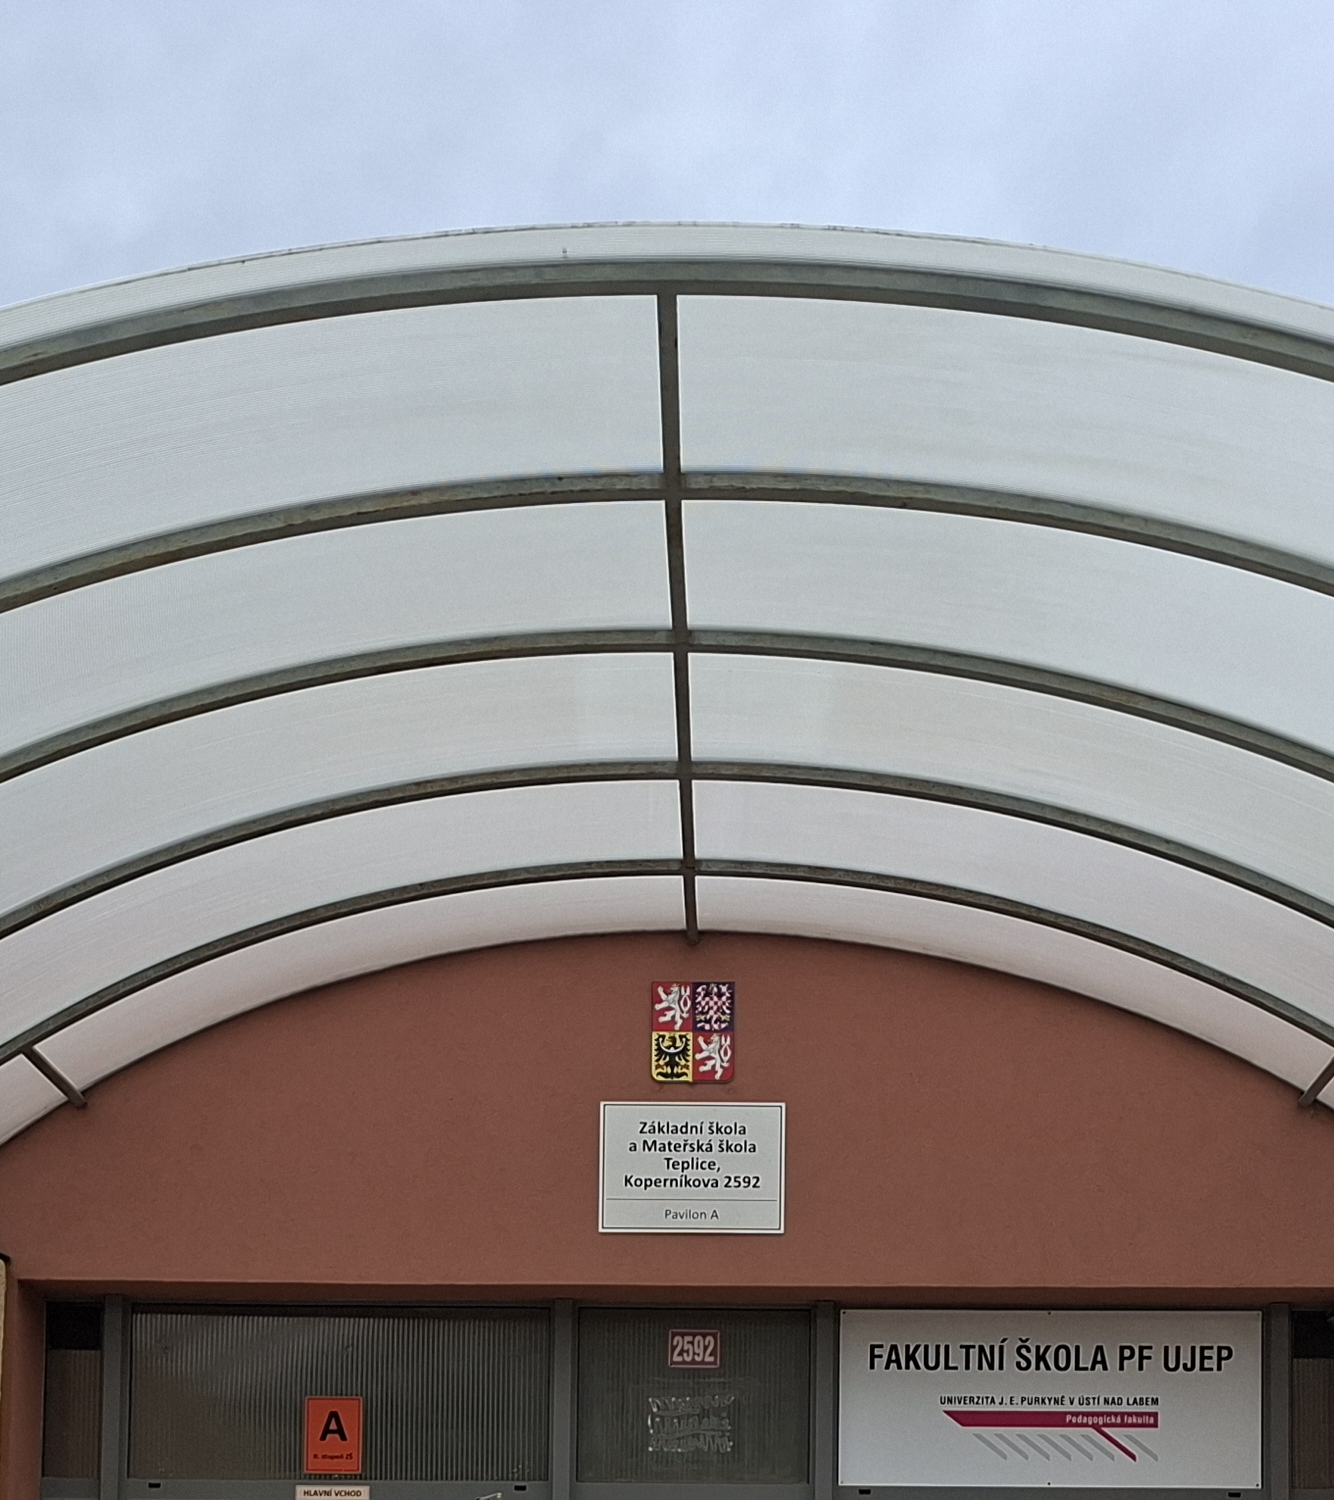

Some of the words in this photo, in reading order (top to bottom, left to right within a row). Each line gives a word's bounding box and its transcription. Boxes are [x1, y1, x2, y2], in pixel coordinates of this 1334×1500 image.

[639, 1121, 704, 1135] Základní
[707, 1121, 747, 1136] škola
[628, 1142, 637, 1152] a
[642, 1139, 713, 1153] Mateřská
[717, 1139, 756, 1153] škola
[664, 1157, 721, 1174] Teplice,
[624, 1174, 719, 1190] Koperníkova
[723, 1175, 761, 1189] 2592
[664, 1208, 706, 1220] Pavilon
[710, 1209, 719, 1220] A
[672, 1335, 715, 1362] 2592
[868, 1337, 1010, 1372] FAKULTNÍ
[1014, 1337, 1110, 1373] ŠKOLA
[1118, 1343, 1154, 1373] PF
[1163, 1344, 1235, 1374] UJEP
[939, 1395, 997, 1407] UNIVERZITA
[998, 1395, 1008, 1407] J.
[1009, 1396, 1019, 1407] E.
[1020, 1394, 1066, 1408] PURKYNĚ
[1068, 1396, 1076, 1408] V
[1077, 1394, 1101, 1408] ÚSTÍ
[1102, 1396, 1124, 1408] NAD
[1126, 1396, 1160, 1408] LABEM
[319, 1410, 349, 1442] A
[1066, 1413, 1122, 1426] Pedagogická
[1123, 1413, 1155, 1425] fakulta
[303, 1488, 332, 1497] HLAVNÍ
[334, 1489, 362, 1497] VCHOD
